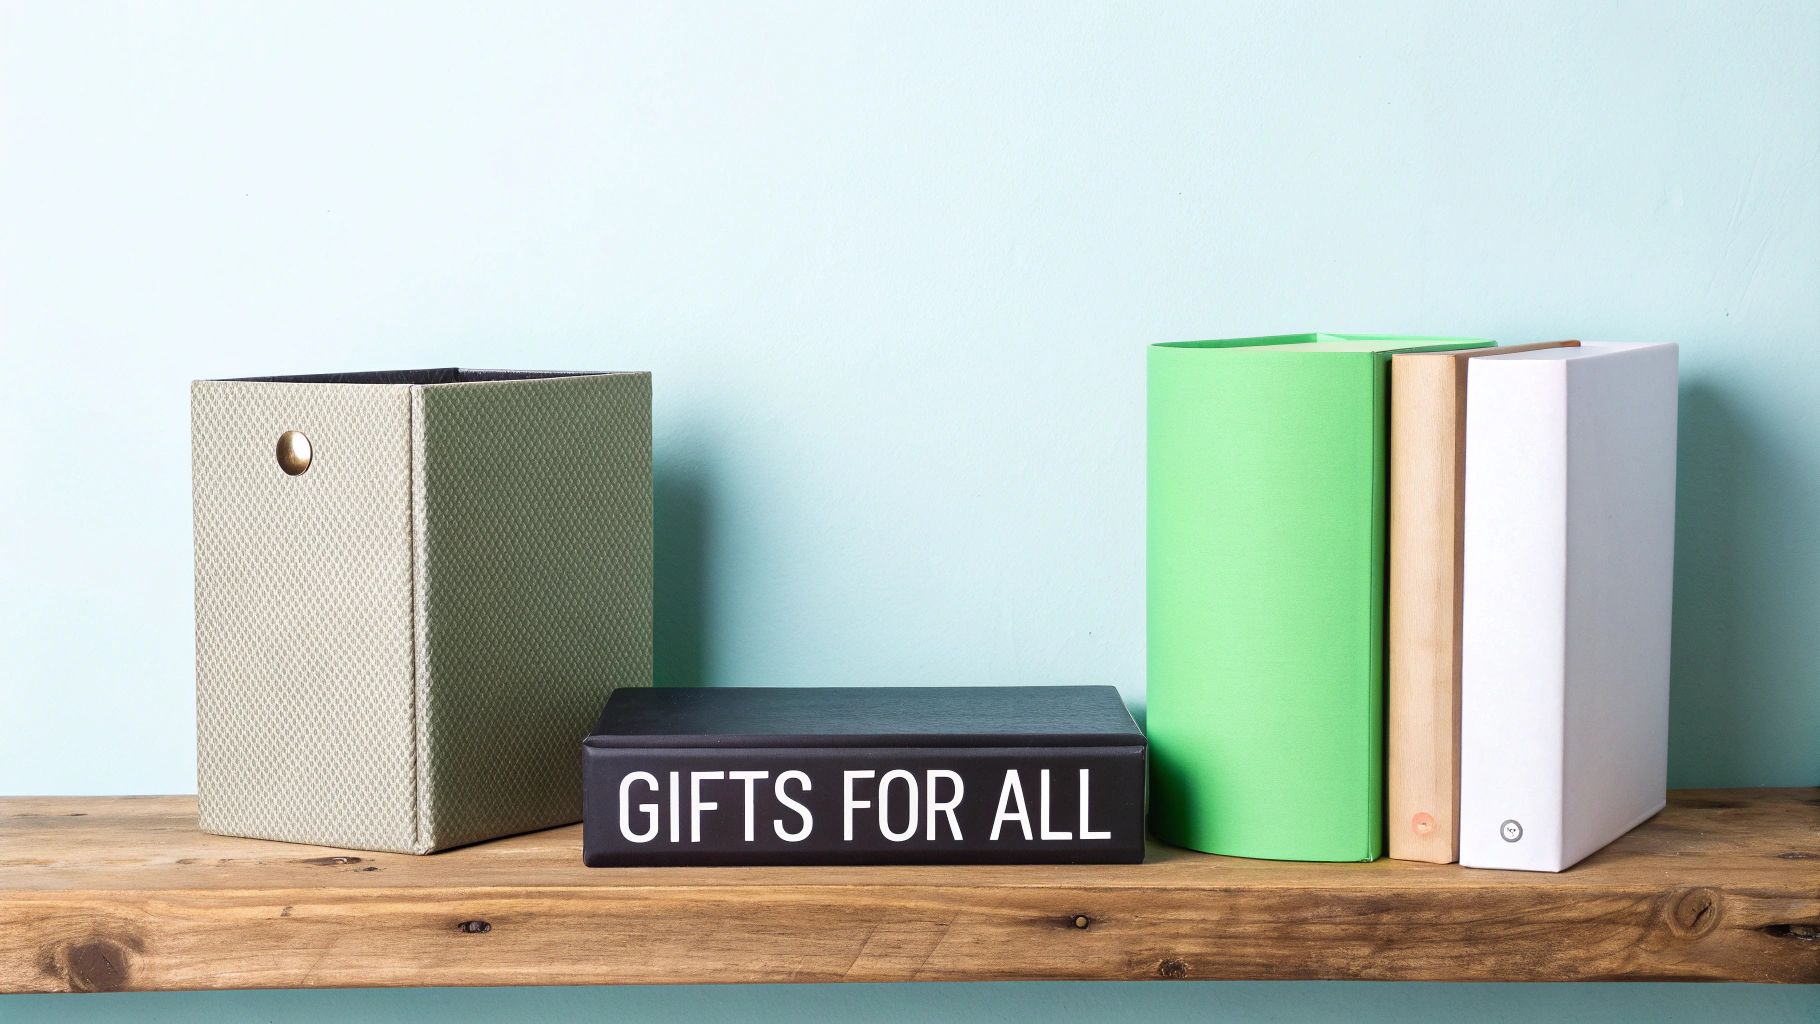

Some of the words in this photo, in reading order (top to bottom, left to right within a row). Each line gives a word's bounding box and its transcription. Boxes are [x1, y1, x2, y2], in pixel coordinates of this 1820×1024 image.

[619, 770, 814, 843] GIFTS
[843, 769, 965, 841] FOR
[989, 768, 1112, 841] ALL
